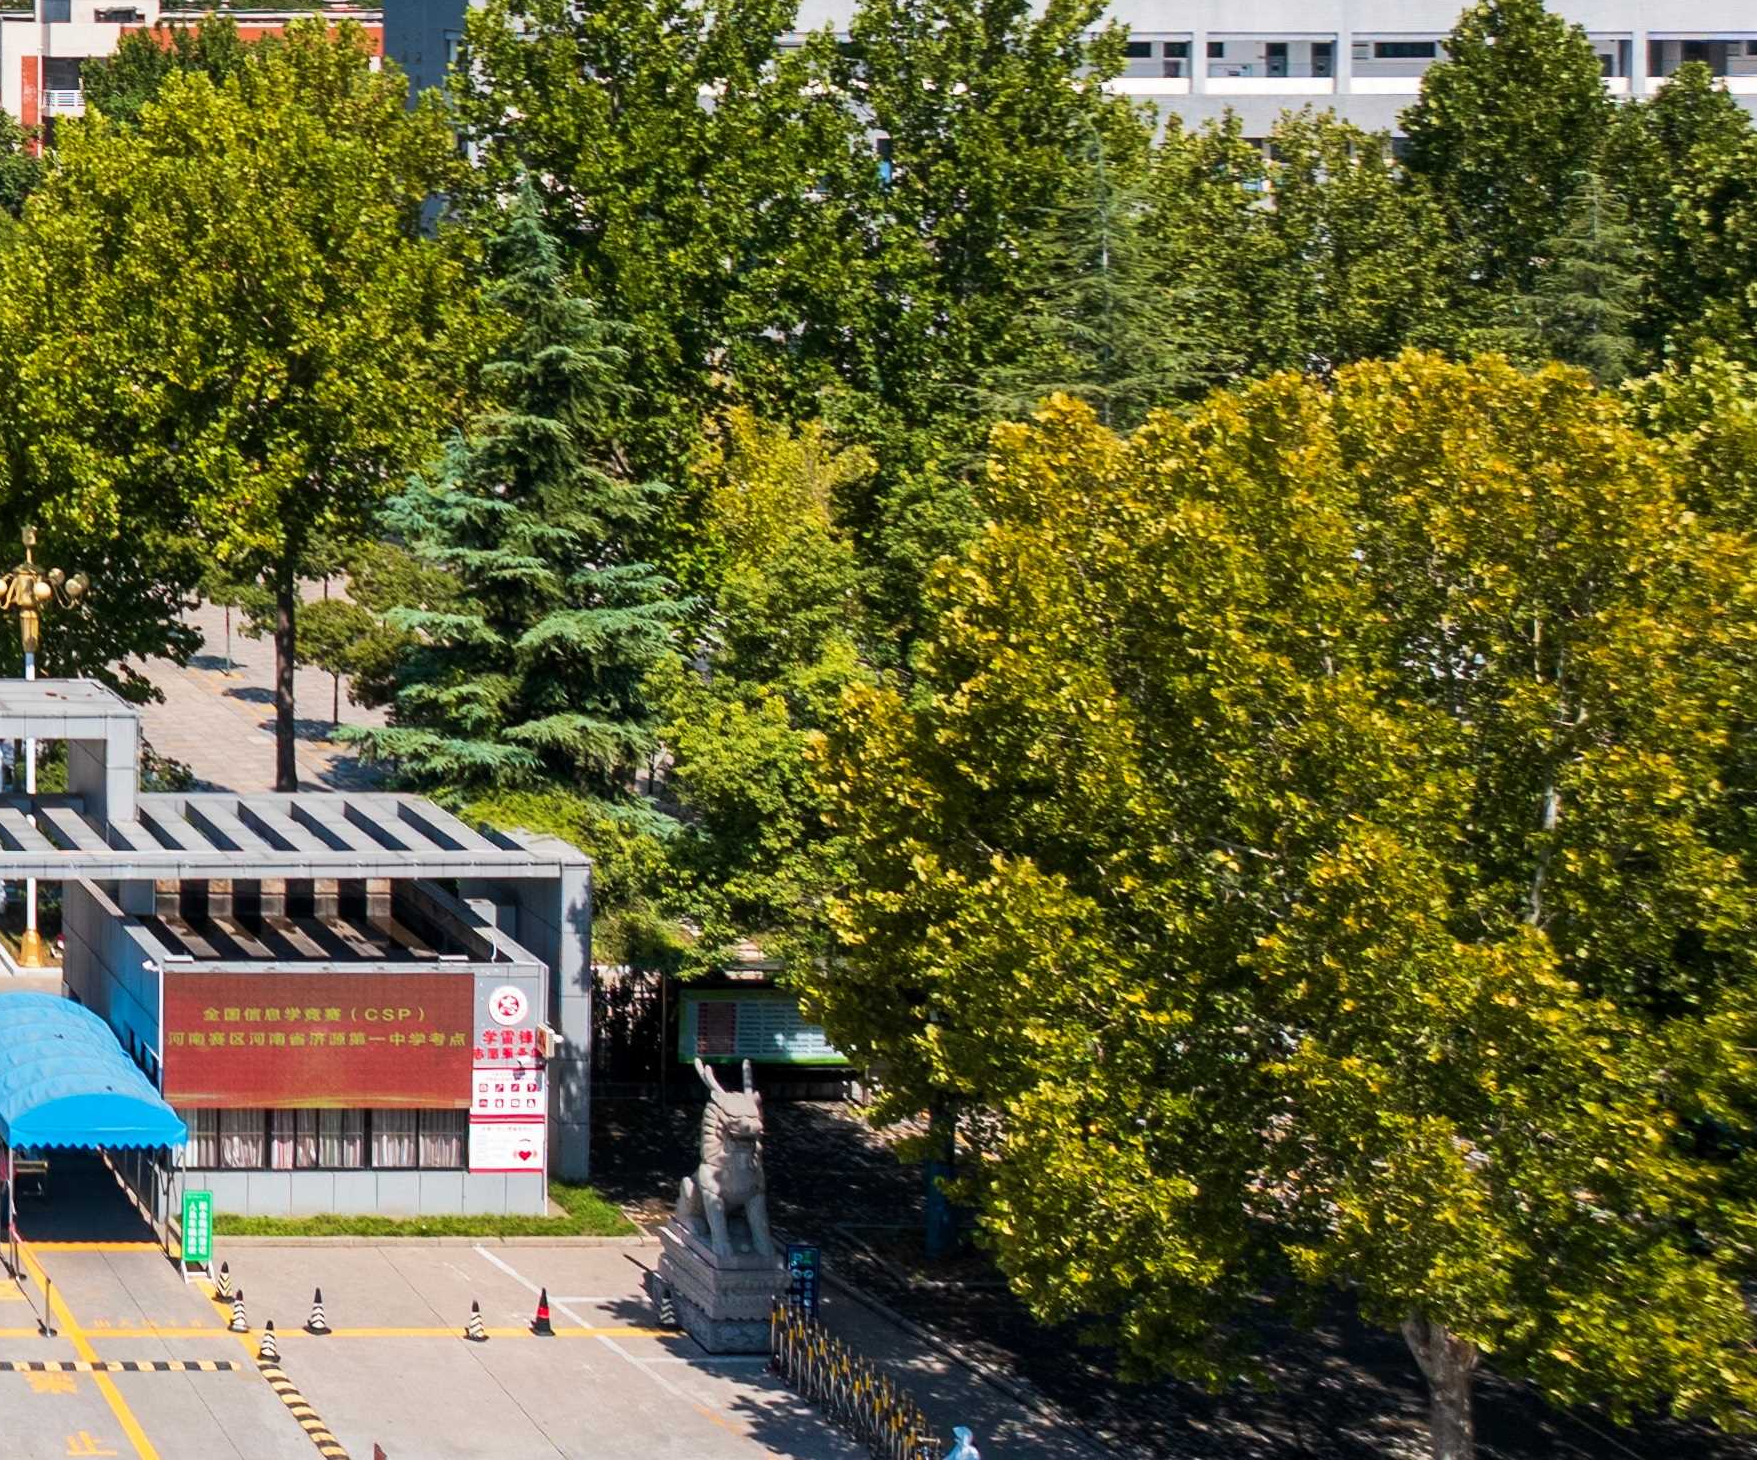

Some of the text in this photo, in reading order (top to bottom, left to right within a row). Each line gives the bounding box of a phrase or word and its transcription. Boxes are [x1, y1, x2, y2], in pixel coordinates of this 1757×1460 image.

[168, 1032, 467, 1047] 河南赛区河南省济源第一中学考点
[482, 1028, 535, 1045] 学雷锋
